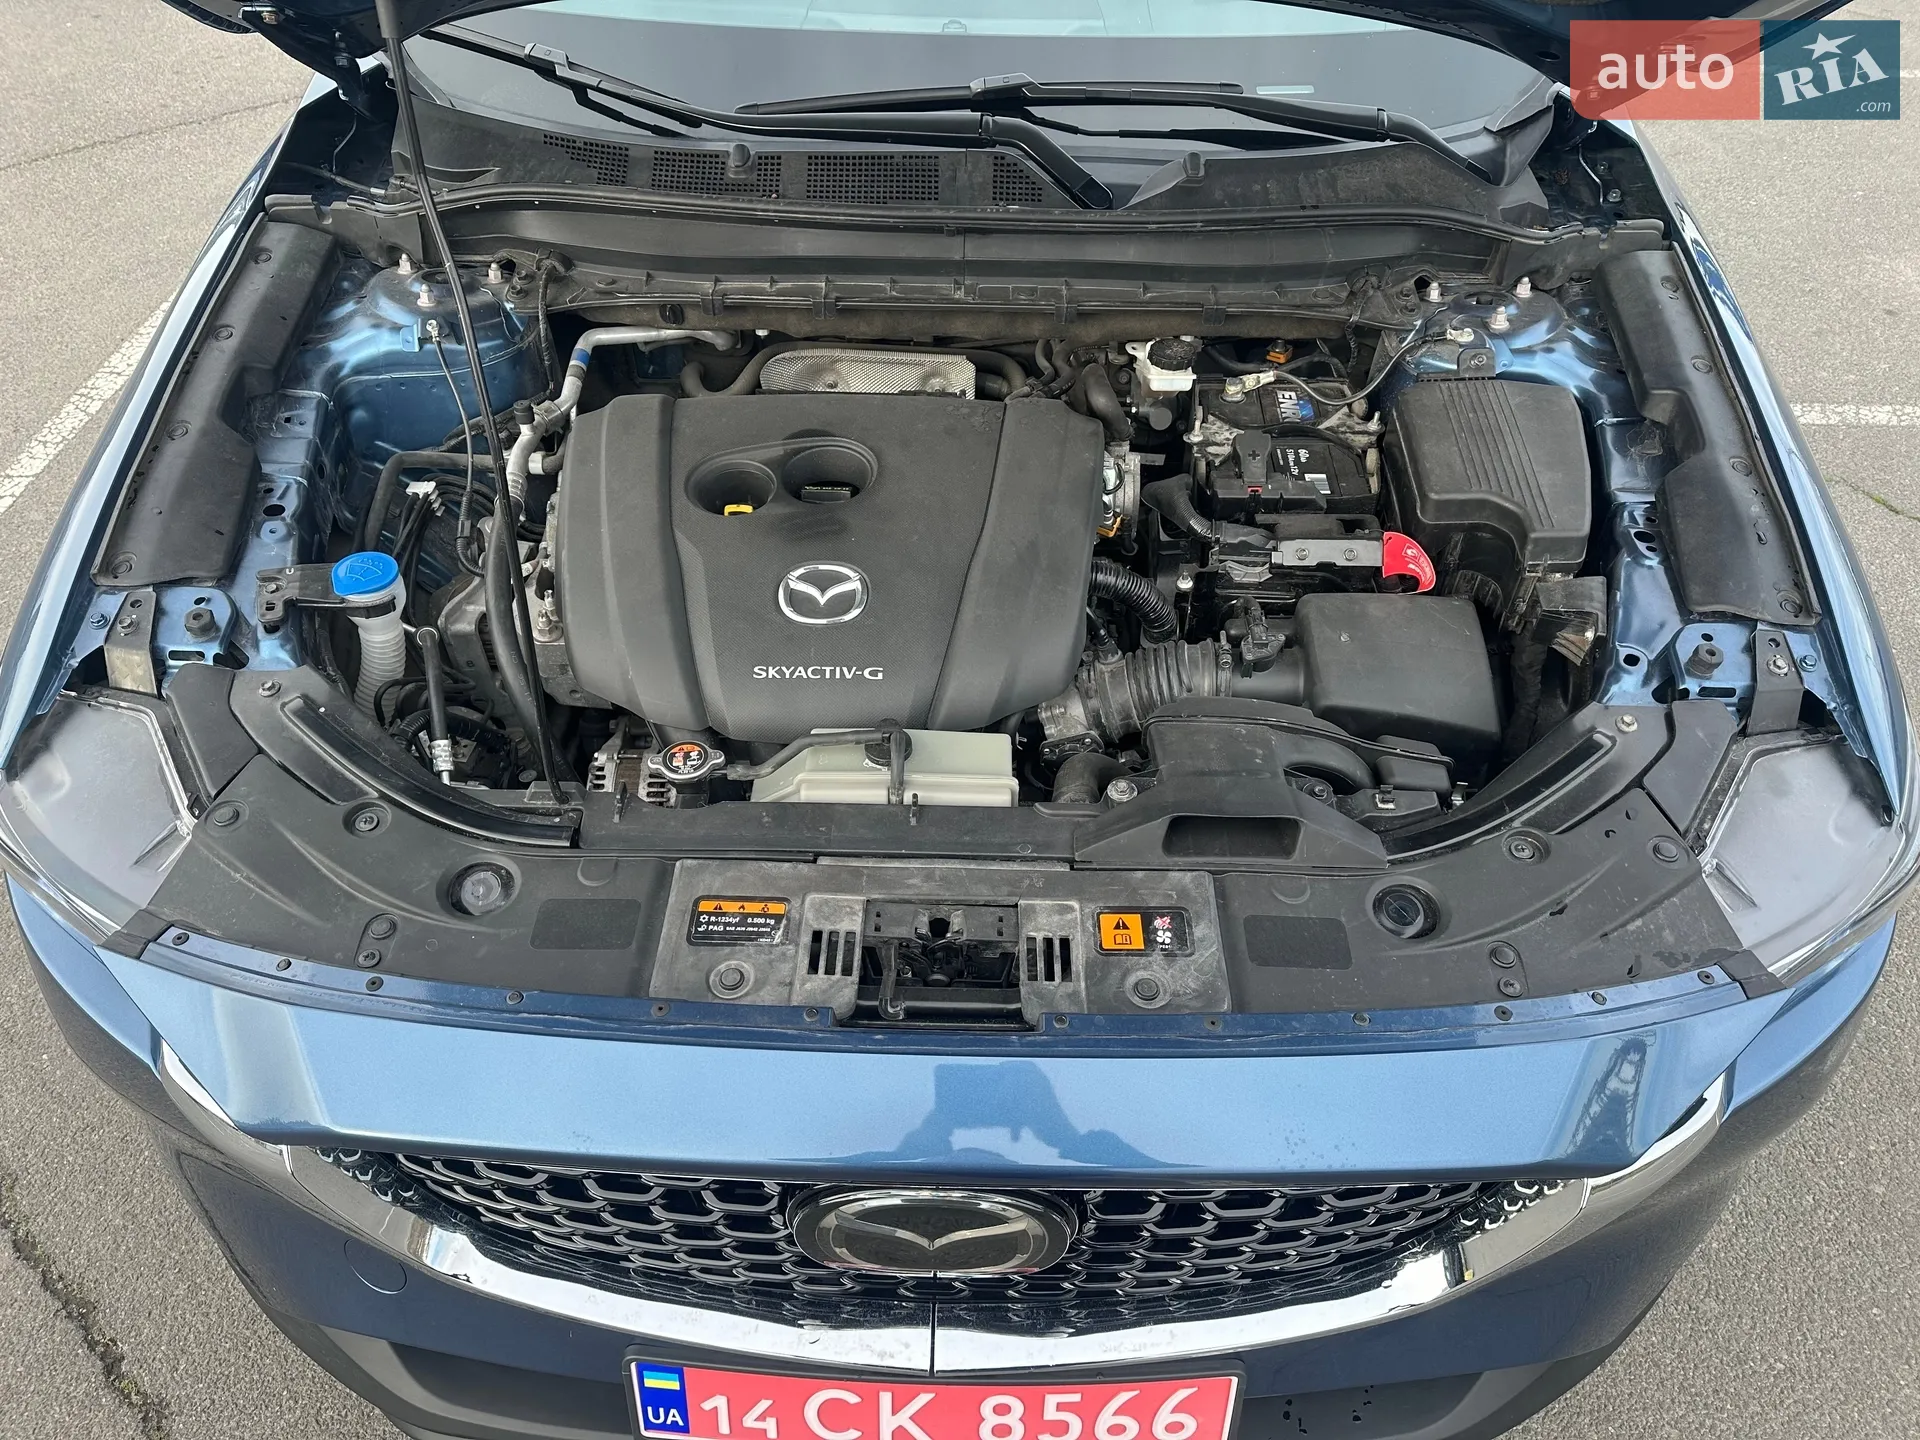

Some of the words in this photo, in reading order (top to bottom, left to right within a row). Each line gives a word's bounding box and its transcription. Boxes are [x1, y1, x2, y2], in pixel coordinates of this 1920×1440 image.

[753, 666, 883, 679] SKYACTIV-G
[710, 916, 740, 924] R-1234yf
[647, 1406, 684, 1426] UA
[700, 1394, 779, 1439] 14
[803, 1388, 938, 1440] CK
[978, 1385, 1200, 1440] 8566
